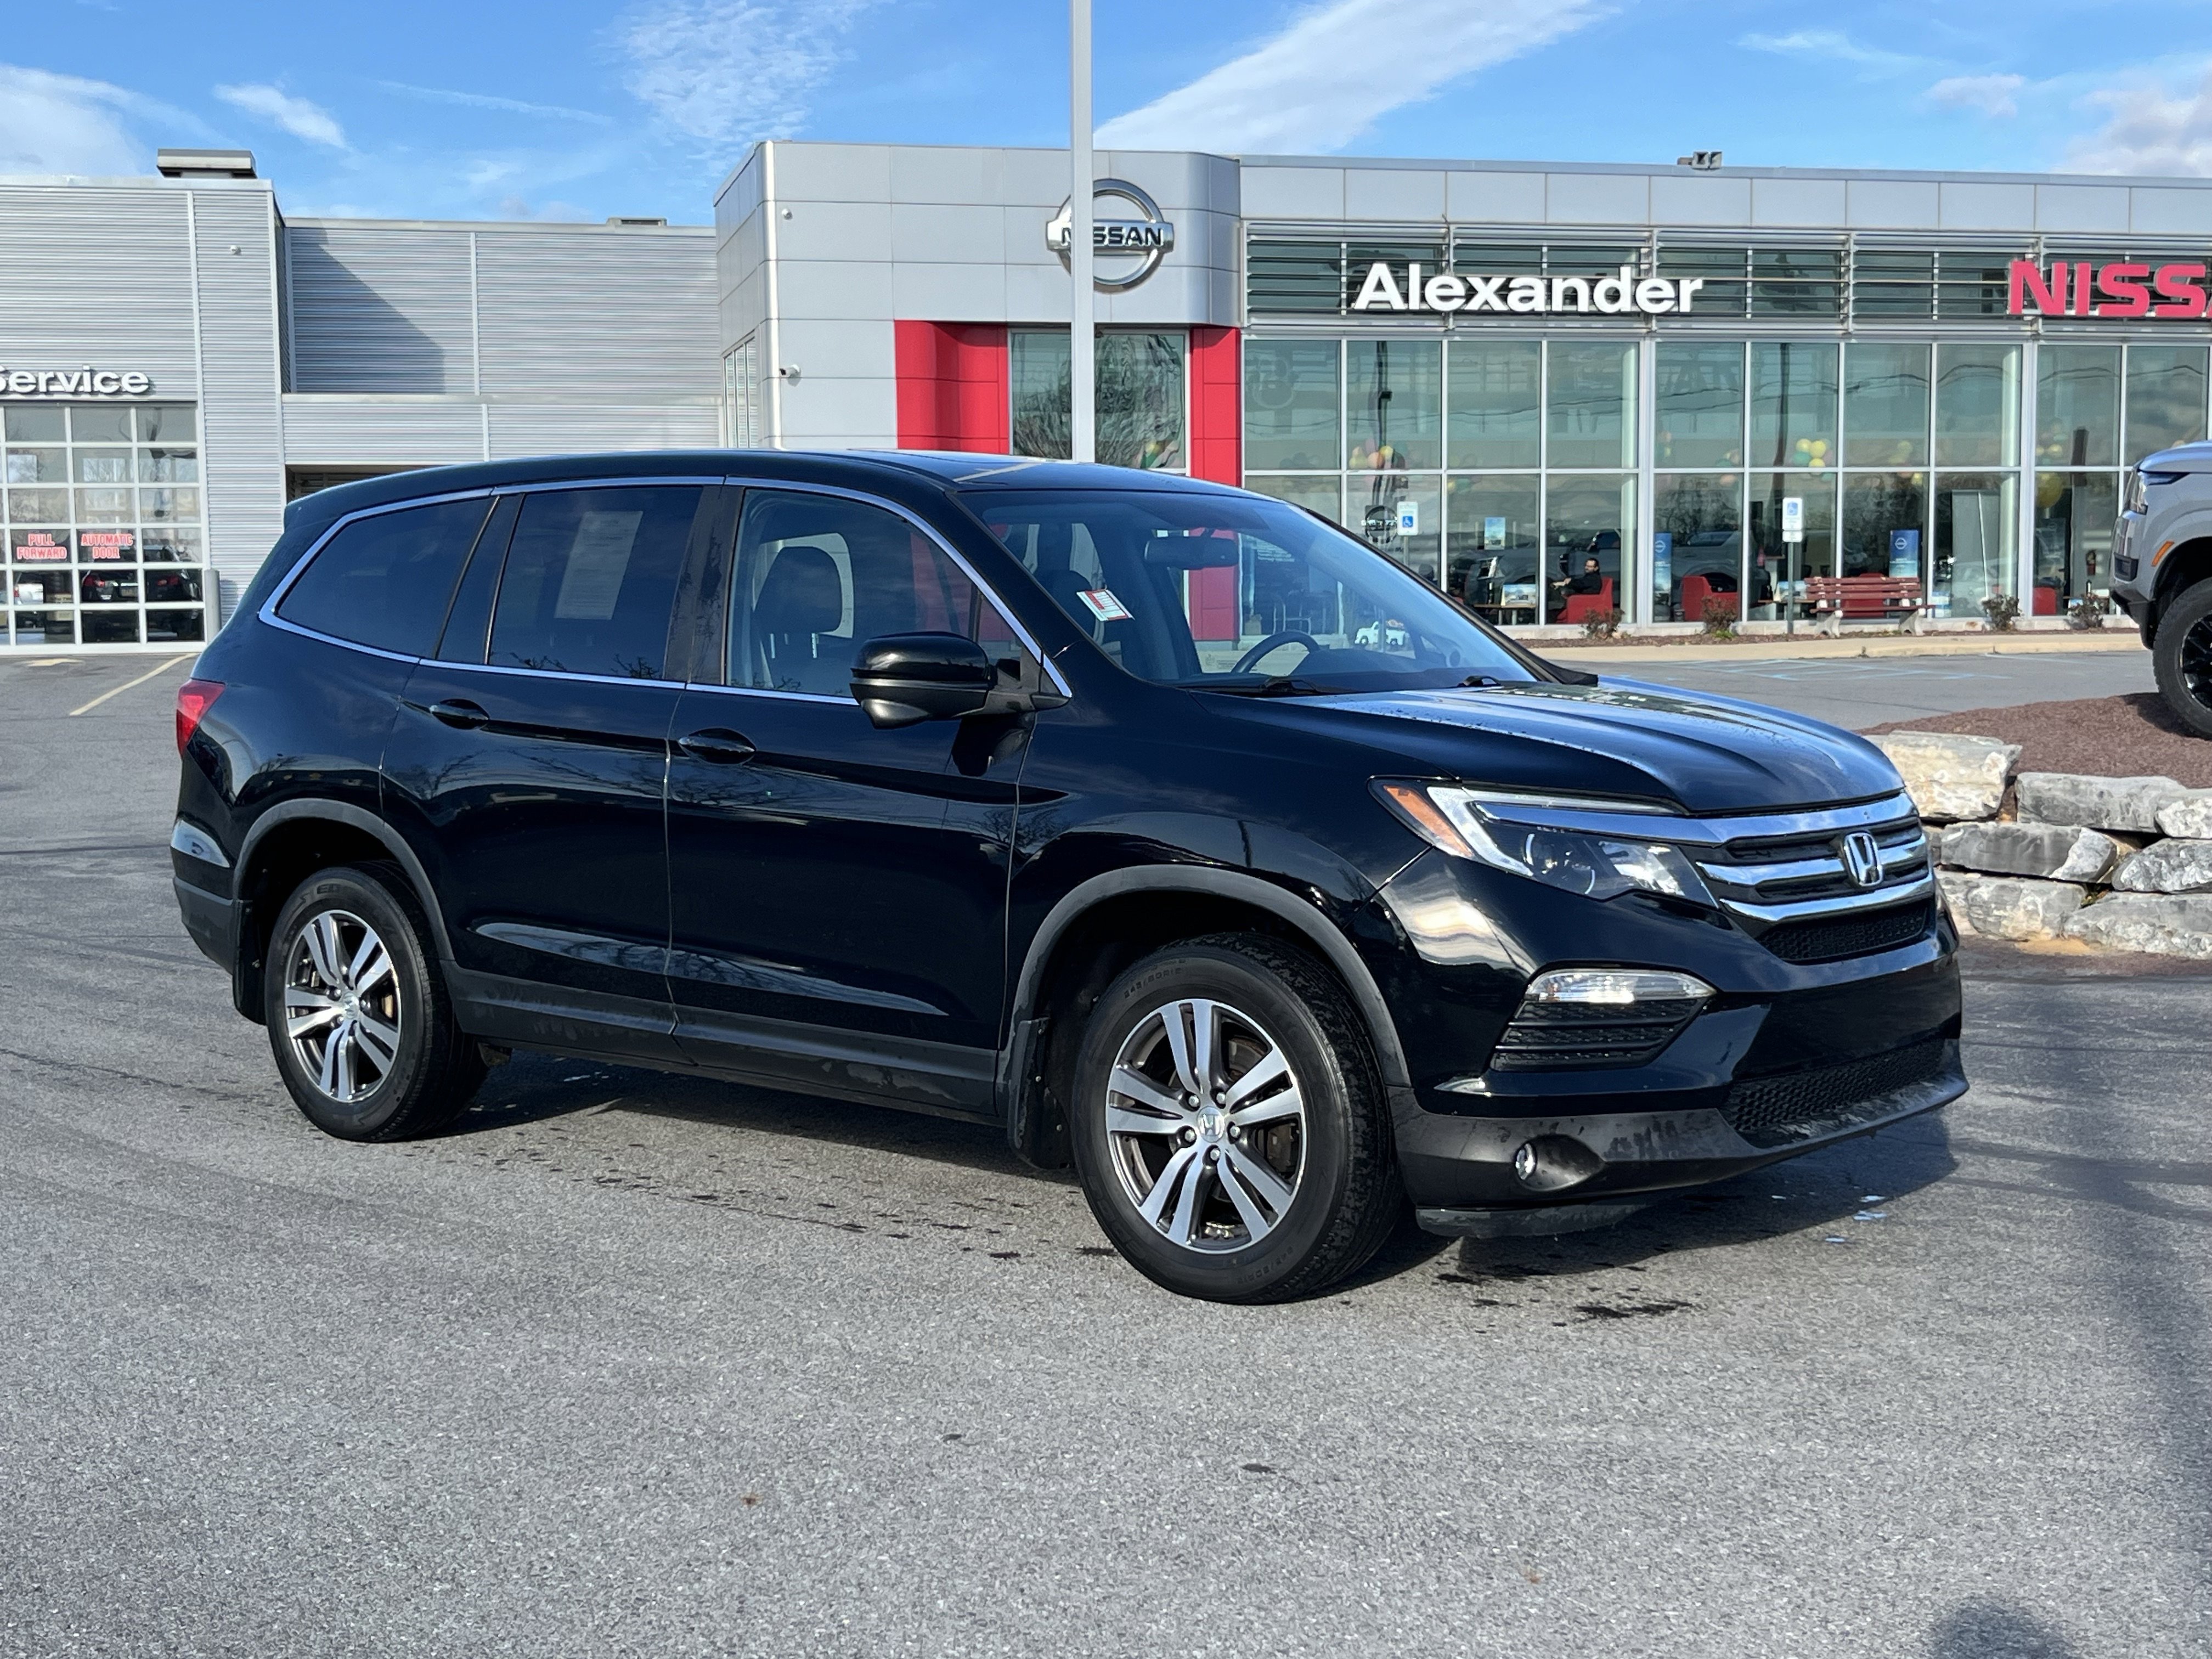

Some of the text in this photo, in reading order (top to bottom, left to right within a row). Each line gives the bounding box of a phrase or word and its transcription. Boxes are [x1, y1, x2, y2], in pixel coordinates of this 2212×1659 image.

[1062, 227, 1163, 246] NSSAN
[1353, 263, 1703, 314] Alexander
[2008, 260, 2212, 317] NISS
[28, 533, 55, 546] PULL
[81, 533, 133, 546] AUTOMATIC
[16, 546, 67, 560] FORWARD
[92, 546, 120, 559] DOOR
